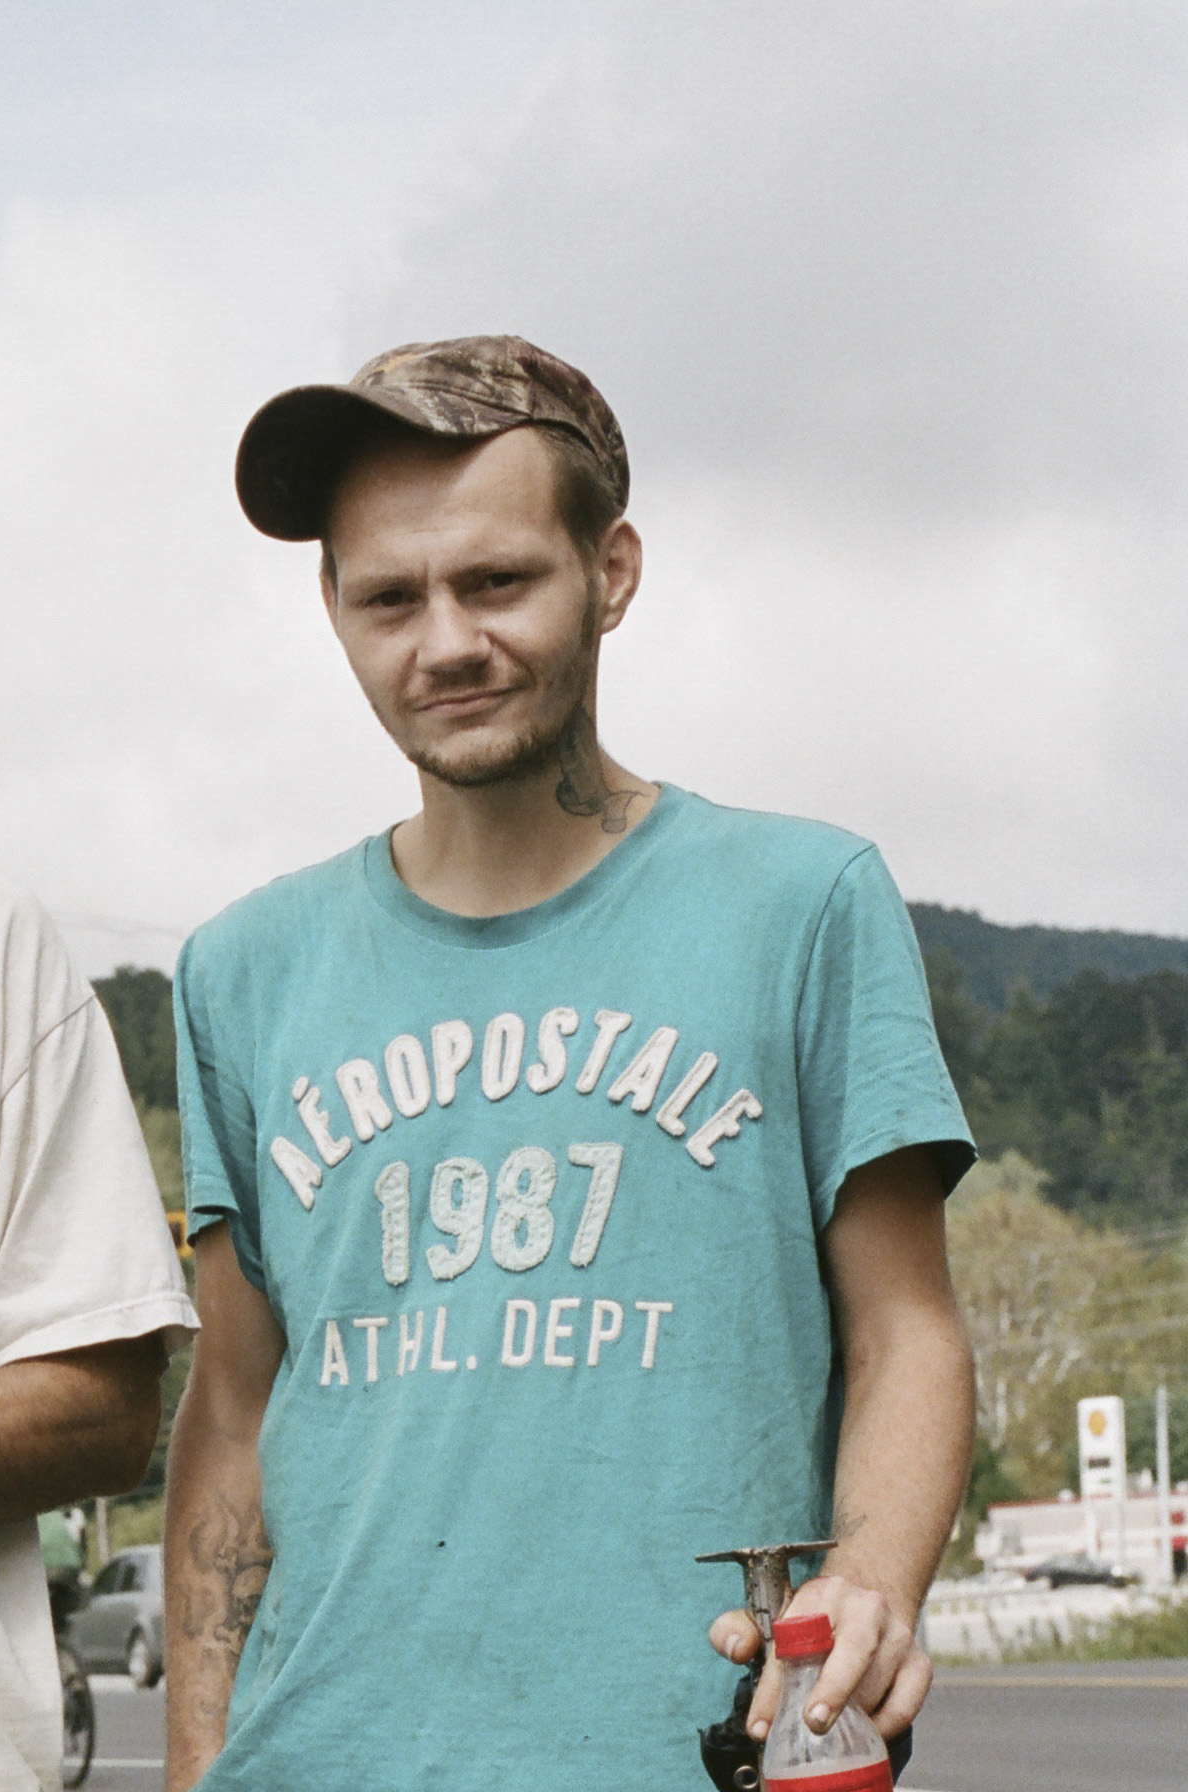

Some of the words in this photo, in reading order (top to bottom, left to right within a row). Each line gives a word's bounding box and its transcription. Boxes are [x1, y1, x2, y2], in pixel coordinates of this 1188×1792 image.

[269, 1006, 762, 1209] AÉROPOSTALE
[373, 1142, 623, 1285] 1987
[319, 1305, 477, 1386] ATHL.
[501, 1296, 675, 1369] DEPT
